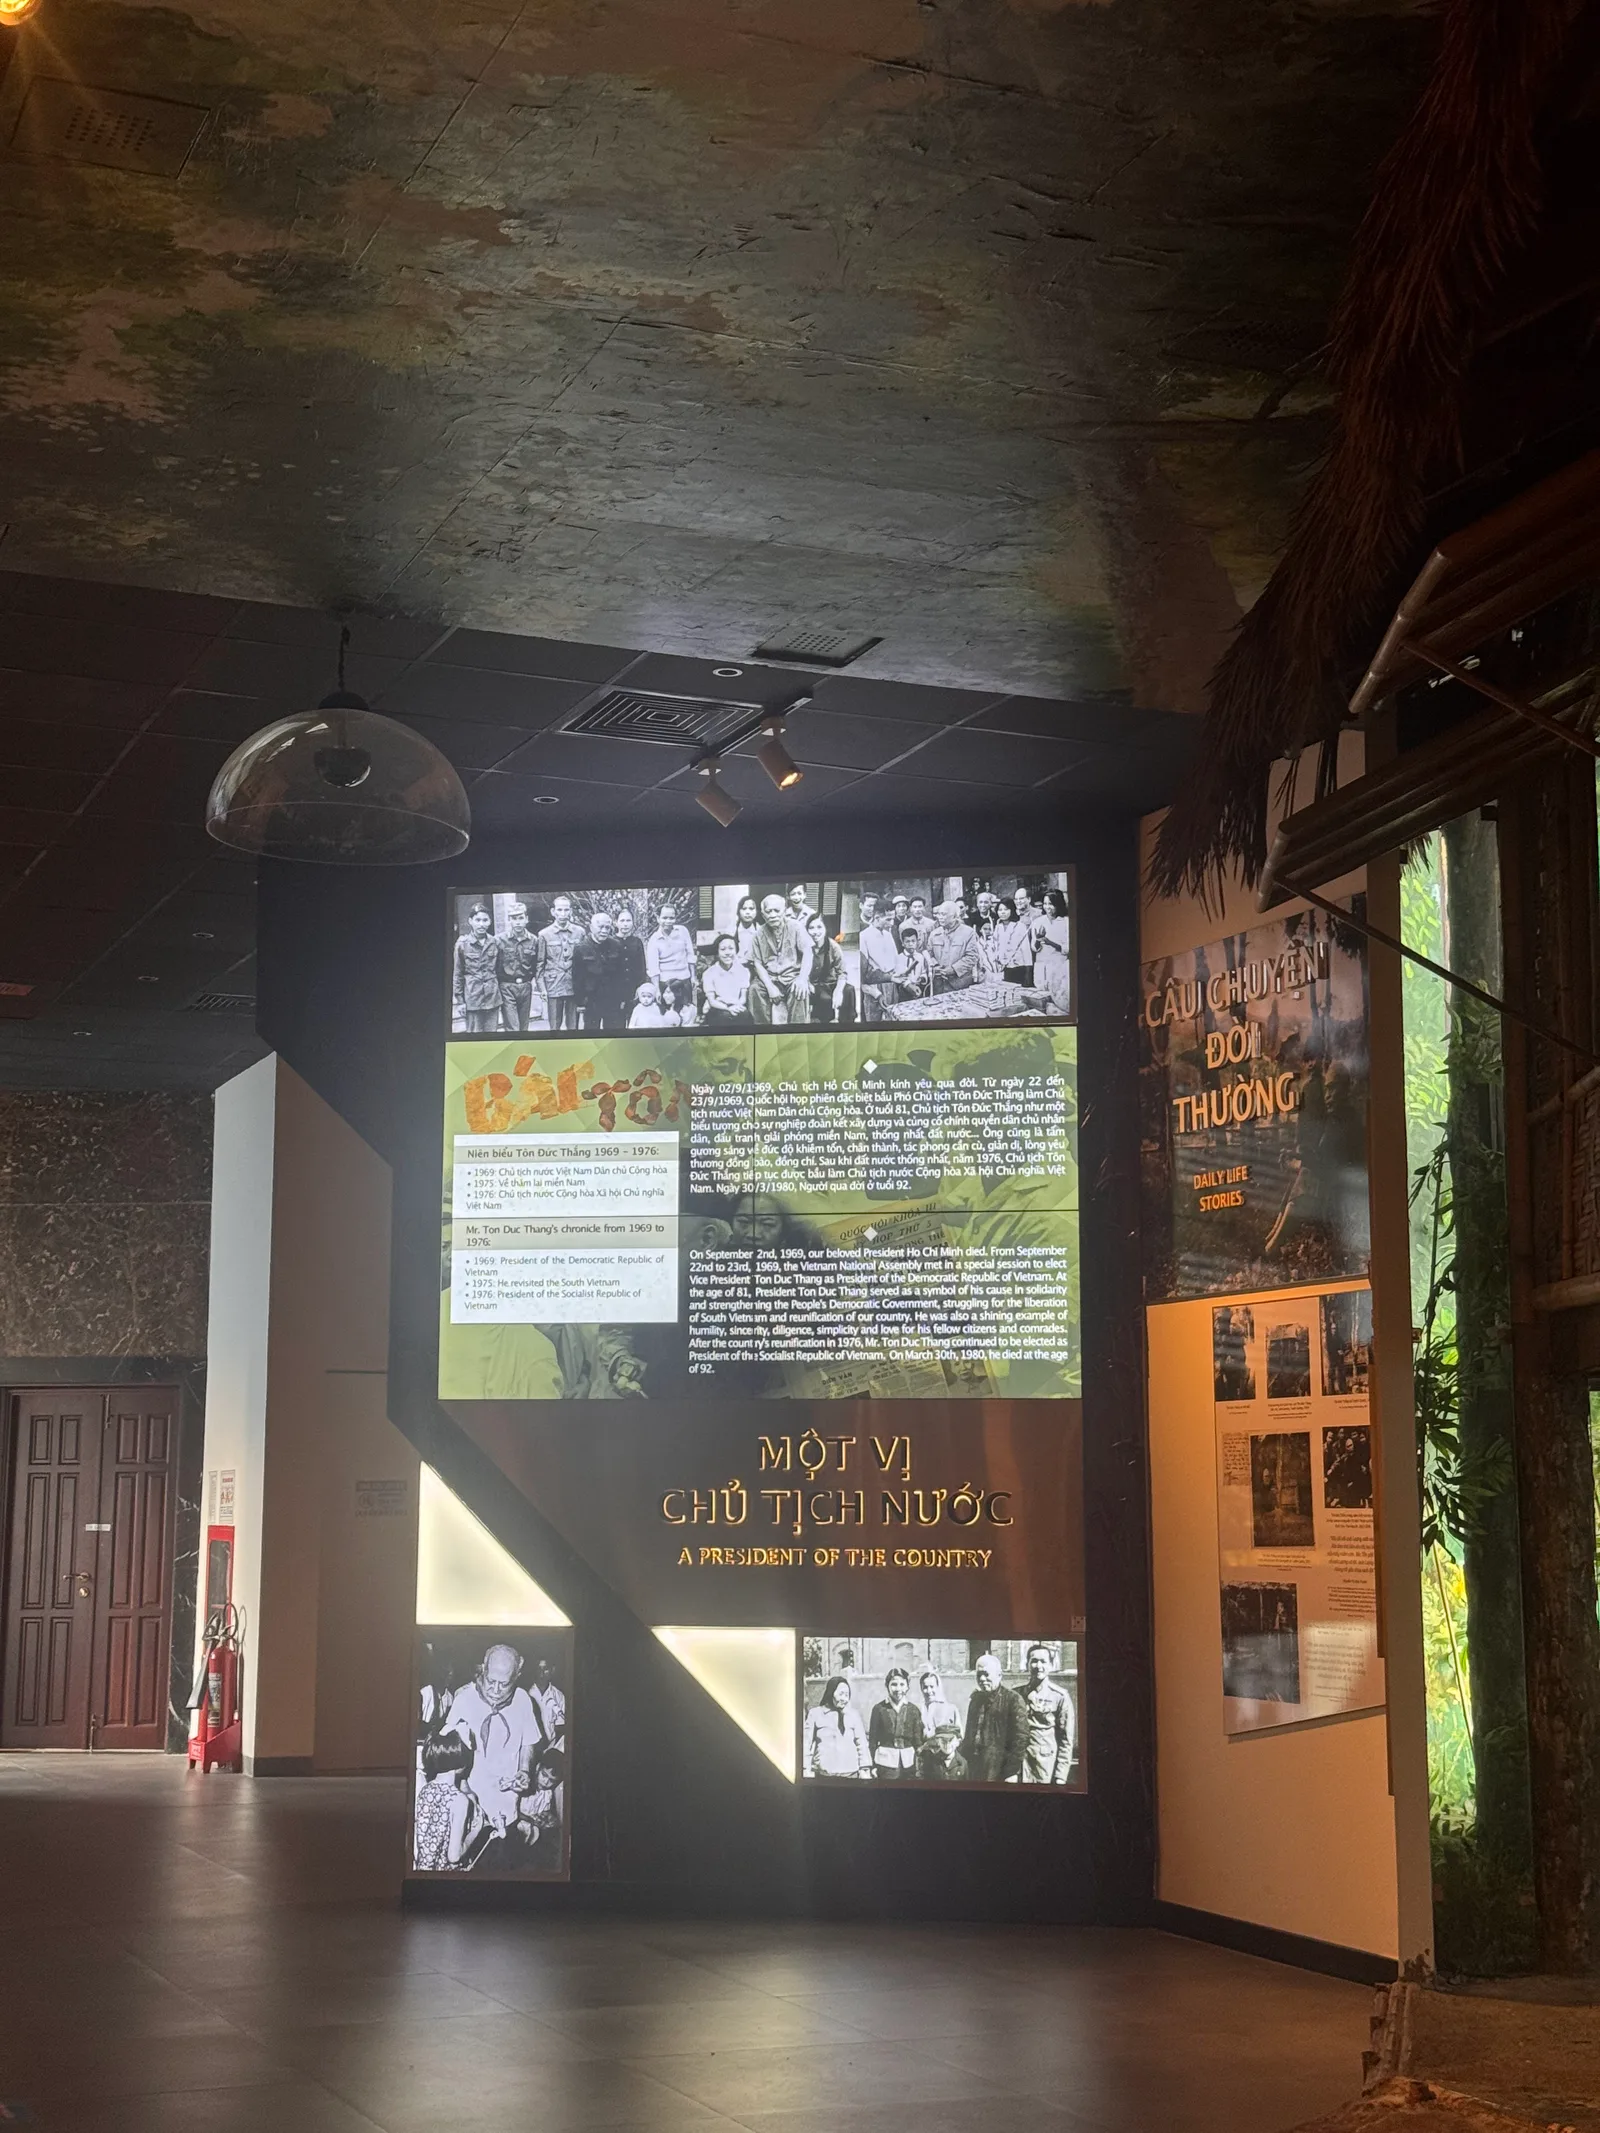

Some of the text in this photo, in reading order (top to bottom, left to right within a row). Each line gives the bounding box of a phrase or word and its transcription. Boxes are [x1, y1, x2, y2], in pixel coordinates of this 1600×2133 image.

[1145, 941, 1330, 1028] CÂU CHUYỆN
[1205, 1018, 1262, 1071] ĐỜI
[862, 1080, 885, 1089] Minh
[937, 1081, 955, 1090] qua
[1028, 1077, 1041, 1086] 22
[1172, 1072, 1302, 1135] THƯỜNG
[595, 1146, 619, 1156] 1969
[573, 1165, 592, 1174] Nam
[566, 1177, 585, 1186] Nam
[1193, 1164, 1250, 1191] DAILY LIFE
[483, 1200, 502, 1209] Nam
[1199, 1191, 1245, 1213] STORIES
[482, 1224, 500, 1233] Ton
[503, 1224, 520, 1233] Duc
[523, 1224, 558, 1235] Thang's
[560, 1223, 600, 1232] chronicle
[603, 1223, 625, 1232] from
[629, 1223, 652, 1232] 1969
[655, 1224, 664, 1232] to
[500, 1255, 537, 1264] President
[540, 1255, 549, 1264] of
[551, 1255, 565, 1264] the
[568, 1254, 614, 1263] Democratic
[617, 1254, 652, 1266] Republic
[655, 1254, 664, 1263] of
[689, 1249, 703, 1258] On
[705, 1249, 753, 1261] September
[826, 1248, 861, 1257] beloved
[863, 1248, 904, 1257] President
[906, 1248, 921, 1257] Ho
[922, 1248, 938, 1256] Chi
[940, 1247, 963, 1256] Minh
[990, 1247, 1015, 1256] From
[1016, 1246, 1067, 1258] September
[464, 1266, 498, 1275] Vietnam
[689, 1262, 713, 1271] 22nd
[715, 1263, 725, 1271] to
[783, 1261, 798, 1270] the
[799, 1261, 837, 1270] Vietnam
[839, 1261, 876, 1270] National
[877, 1261, 922, 1272] Assembly
[923, 1261, 942, 1269] met
[944, 1260, 953, 1269] in
[963, 1260, 994, 1272] special
[996, 1260, 1031, 1269] session
[1044, 1259, 1066, 1268] elect
[497, 1277, 509, 1286] He
[510, 1277, 544, 1286] revisited
[546, 1277, 559, 1286] the
[561, 1277, 584, 1286] South
[586, 1277, 620, 1286] Vietnam
[497, 1289, 534, 1298] President
[535, 1289, 544, 1297] of
[546, 1288, 559, 1297] the
[561, 1288, 594, 1297] Socialist
[596, 1288, 631, 1300] Republic
[632, 1288, 641, 1297] of
[463, 1300, 497, 1309] Vietnam
[757, 1428, 911, 1481] MỘT VỊ
[661, 1479, 1015, 1537] CHỦ TỊCH NƯỚC
[677, 1547, 993, 1568] A PRESIDENT OF THE COUNTRY
